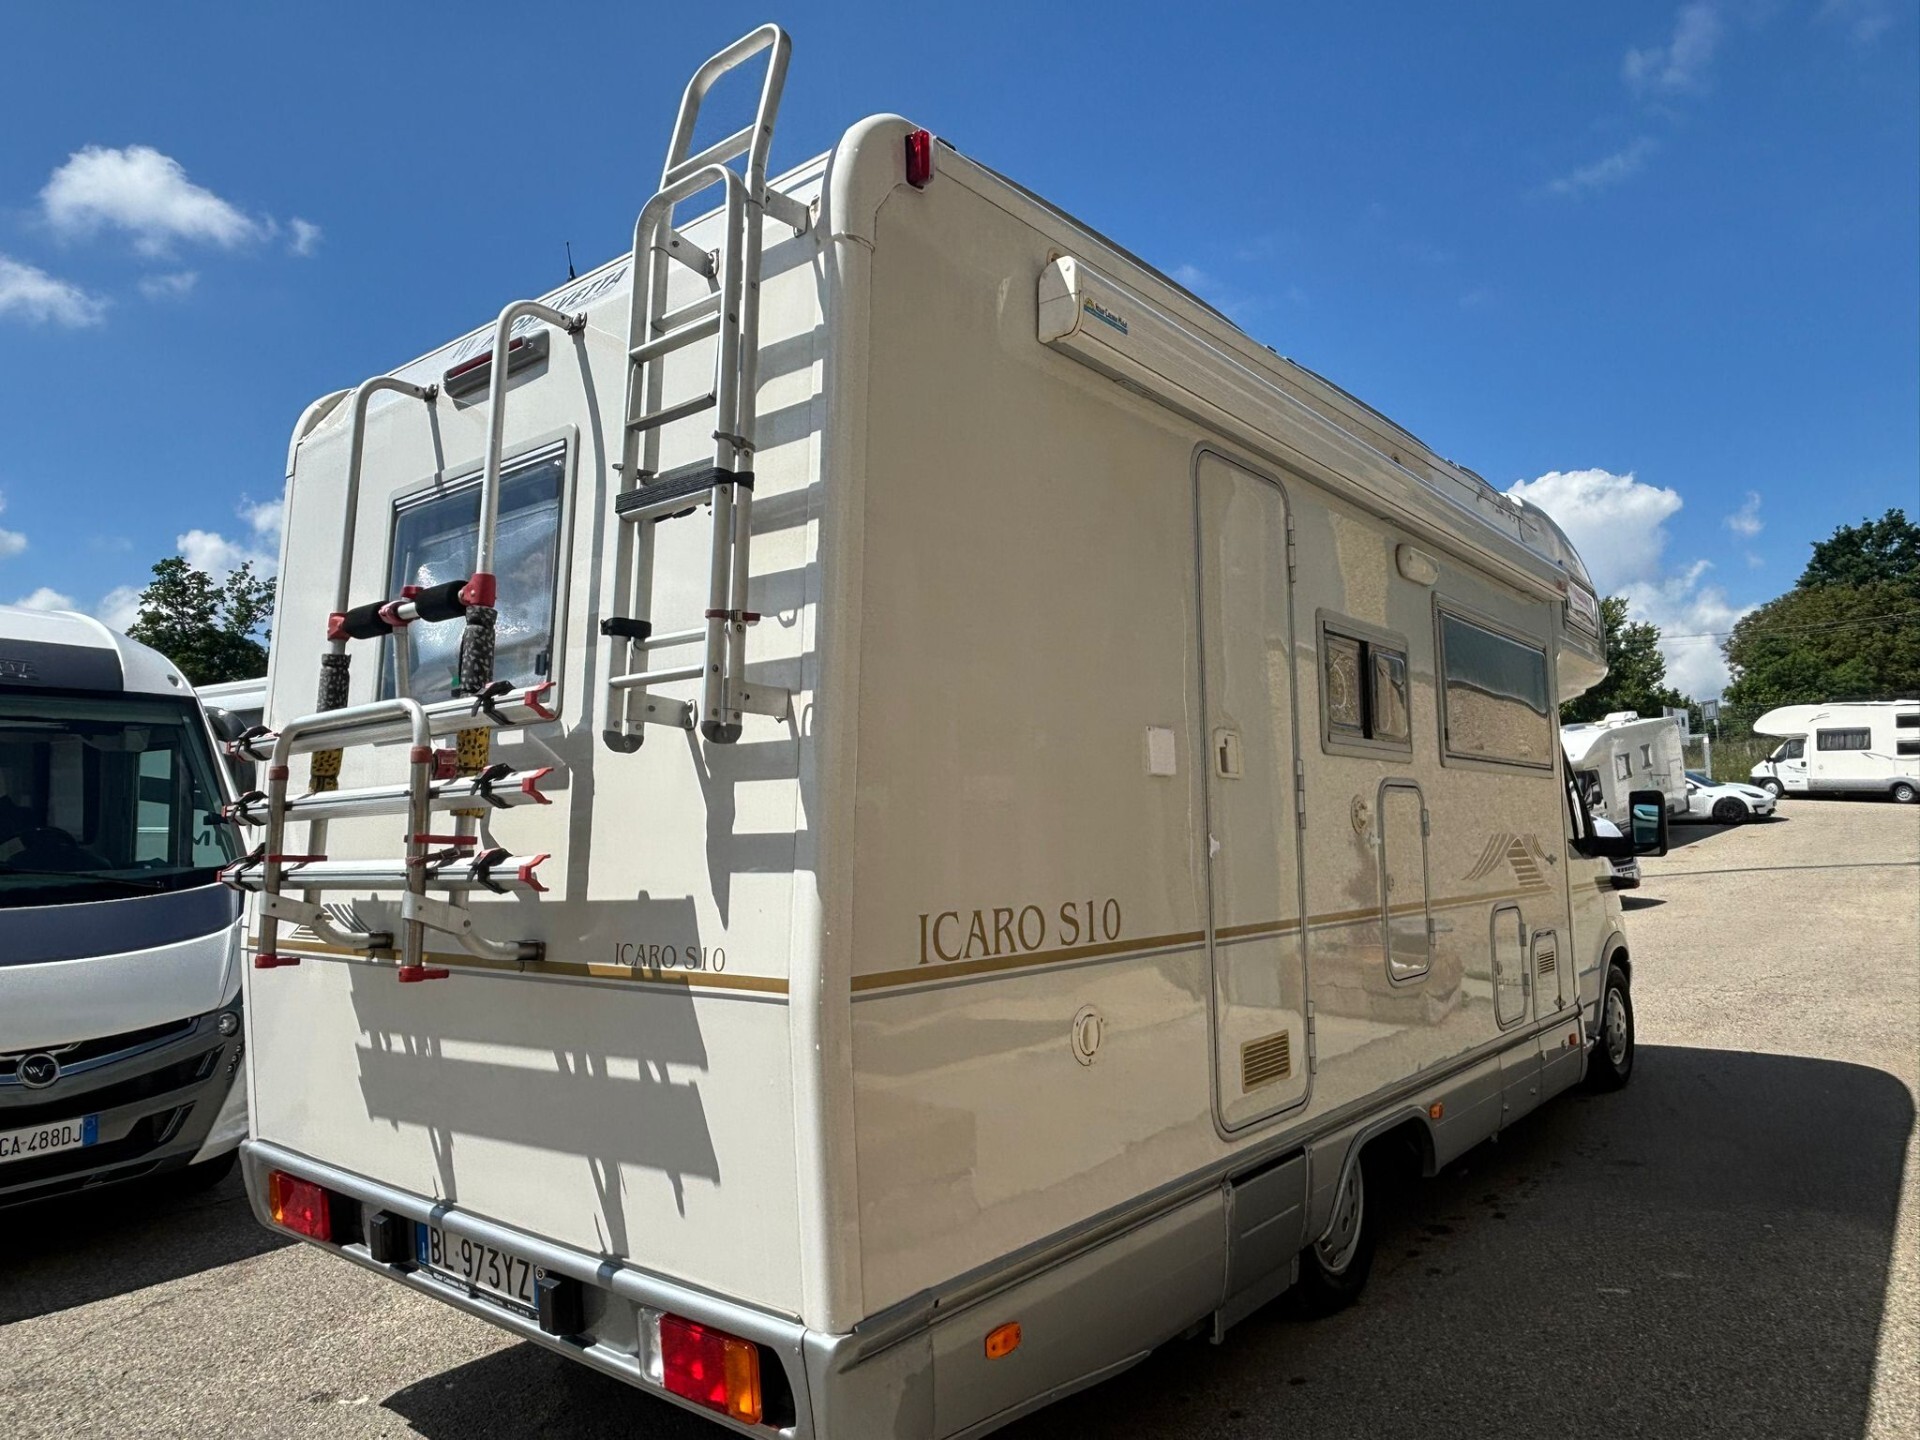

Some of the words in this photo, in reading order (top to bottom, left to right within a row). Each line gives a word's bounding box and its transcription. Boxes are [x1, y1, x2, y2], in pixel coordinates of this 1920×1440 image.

[917, 904, 1045, 964] ICARO
[1059, 898, 1121, 947] S10
[615, 942, 677, 969] ICARO
[684, 946, 726, 973] S10
